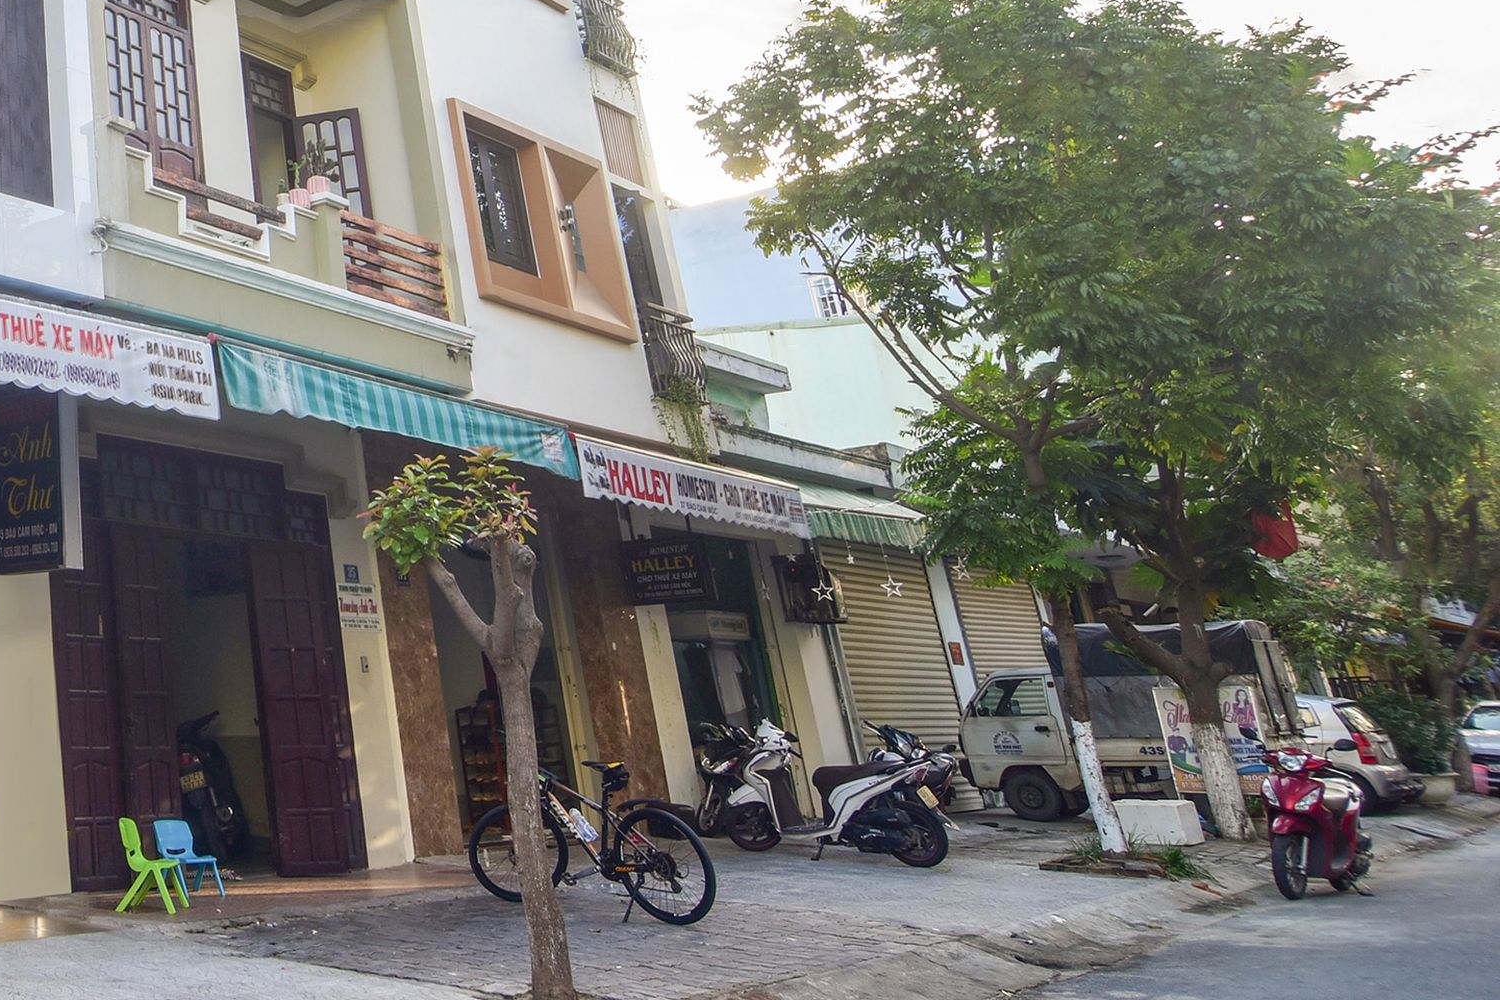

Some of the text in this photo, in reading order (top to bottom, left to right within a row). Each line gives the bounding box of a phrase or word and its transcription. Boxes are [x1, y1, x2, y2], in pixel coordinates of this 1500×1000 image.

[51, 323, 75, 352] XE
[79, 325, 115, 361] MÁY
[177, 347, 204, 365] HILLS
[0, 421, 52, 467] Anh
[607, 458, 673, 506] HALLEY
[675, 472, 718, 504] HOMESTAY
[631, 554, 694, 573] HALLEY
[1139, 746, 1165, 756] 43S
